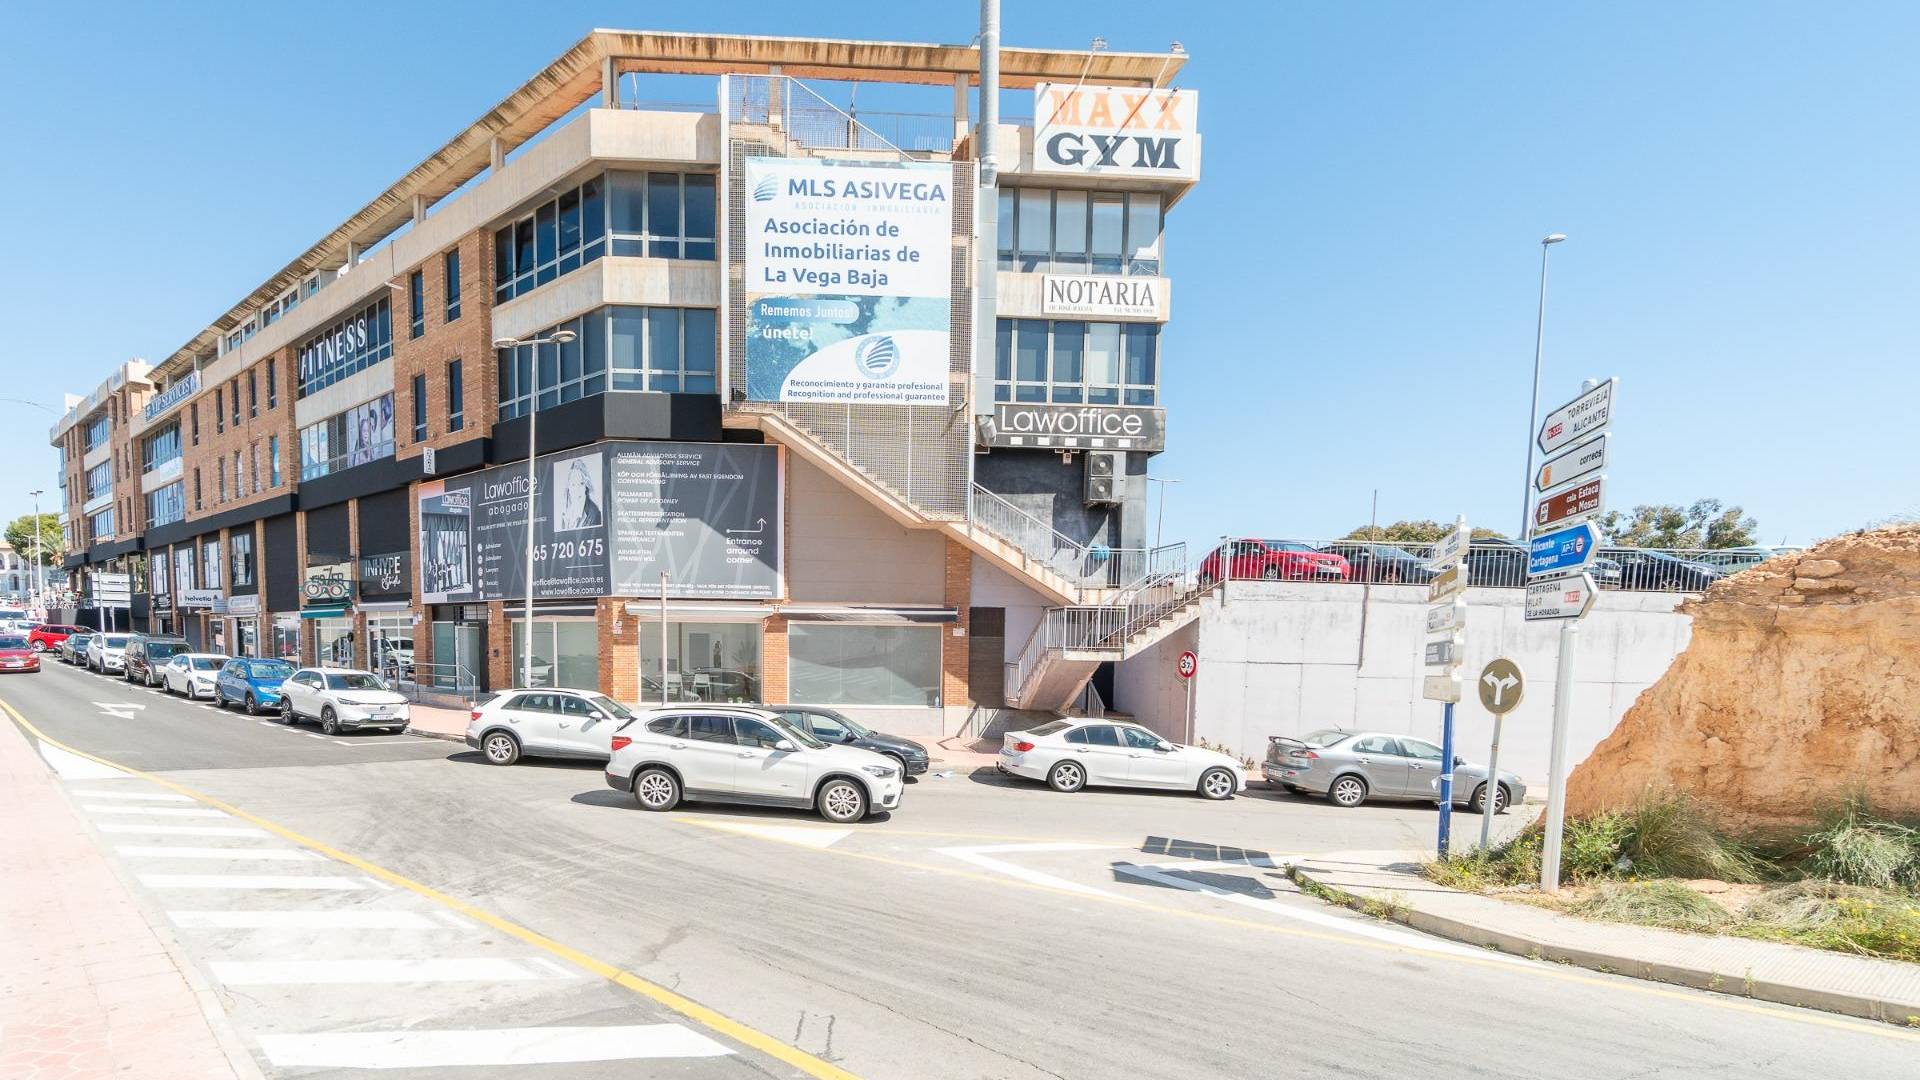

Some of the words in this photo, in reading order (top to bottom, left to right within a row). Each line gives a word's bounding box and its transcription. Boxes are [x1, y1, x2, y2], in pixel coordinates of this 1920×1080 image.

[1049, 89, 1183, 130] MAXX
[1046, 132, 1182, 170] GYM
[788, 178, 836, 198] MLS
[843, 180, 946, 202] ASIVEGA
[764, 217, 870, 236] Asociación
[876, 219, 900, 237] de
[764, 242, 891, 262] Inmobiliarias
[896, 245, 920, 262] de
[764, 266, 786, 282] La
[793, 267, 841, 287] Vega
[847, 269, 889, 288] Baja
[1050, 279, 1154, 306] NOTARIA
[761, 303, 812, 318] Rememos
[763, 325, 814, 340] únete!
[301, 318, 366, 380] FITNESS
[788, 389, 835, 400] Recognition
[837, 390, 851, 399] and
[853, 391, 903, 402] professional
[905, 392, 946, 402] guarantee
[790, 379, 854, 389] Reconocimiento
[855, 382, 861, 390] y
[897, 381, 943, 392] profesional
[1567, 389, 1608, 421] TORREVIEJA
[1001, 406, 1143, 434] Lawoffice
[1572, 407, 1607, 433] ALICANTE
[1579, 449, 1602, 466] correos
[484, 475, 538, 500] Lawoffice
[1578, 483, 1599, 498] Estaca
[1578, 498, 1598, 513] Mosca
[525, 544, 548, 562] 65
[551, 541, 574, 560] 720
[578, 538, 604, 557] 675
[726, 537, 763, 546] Entrance
[1531, 538, 1555, 553] Alicante
[365, 555, 401, 577] INHYPE
[1530, 554, 1559, 568] Cartagena
[1528, 582, 1561, 595] CARTAGENA
